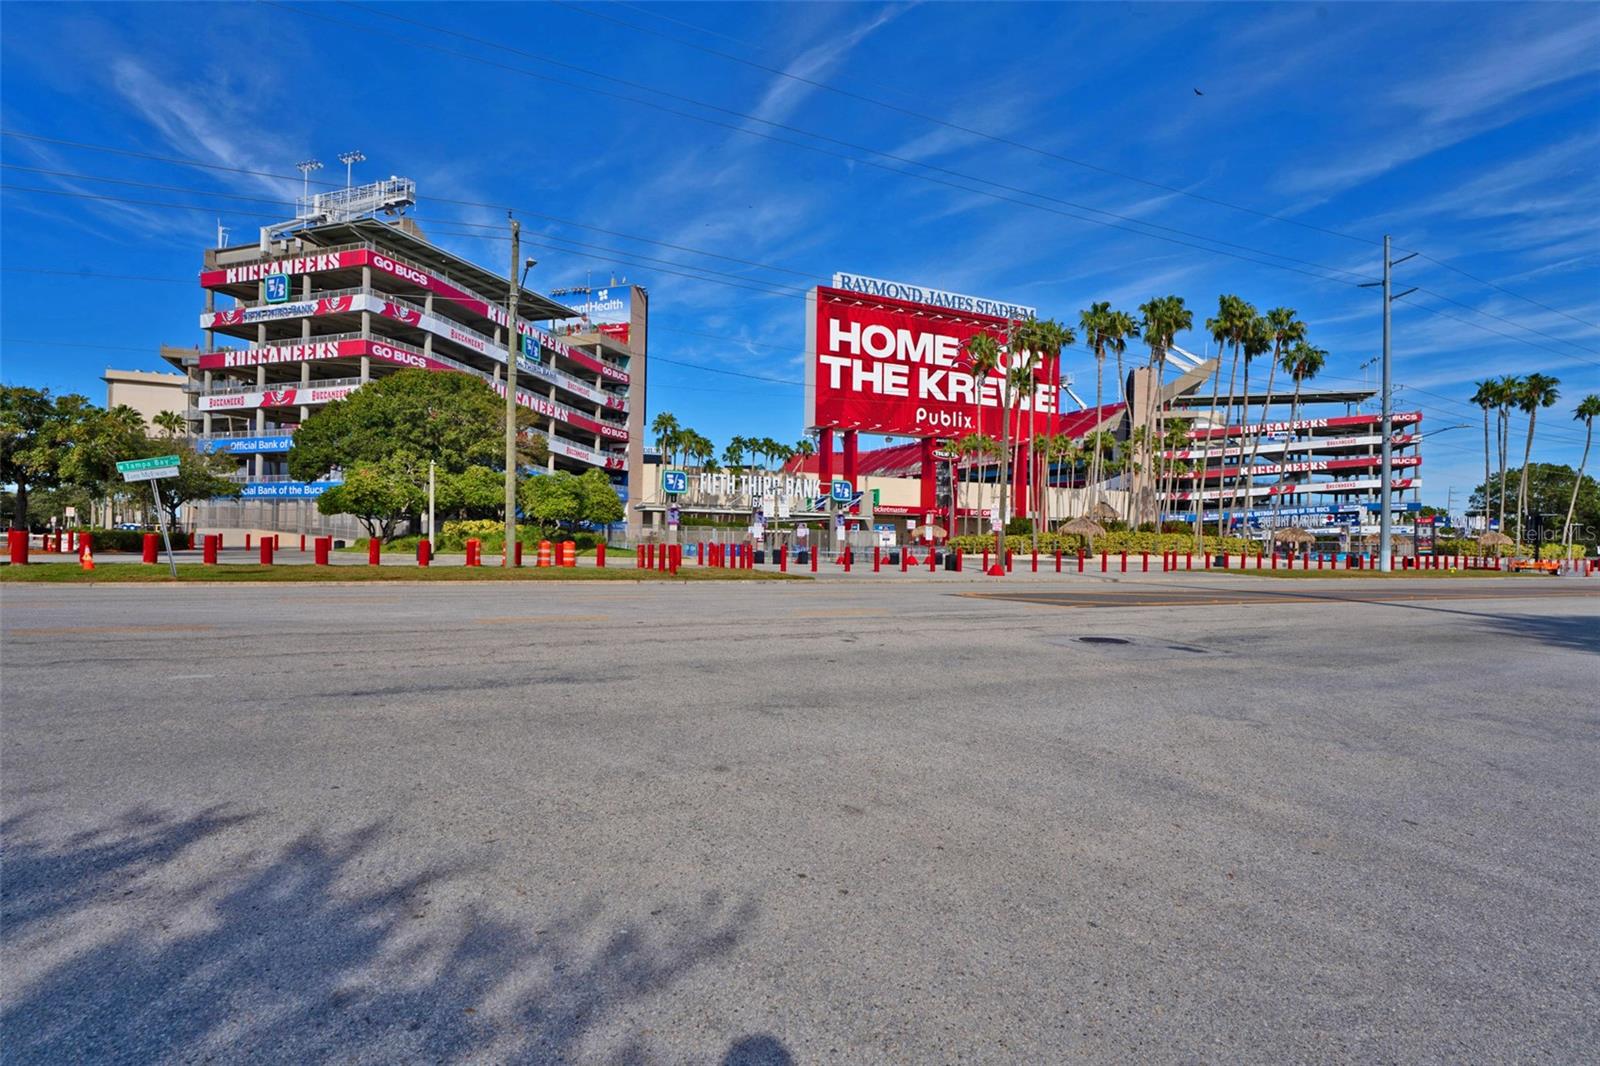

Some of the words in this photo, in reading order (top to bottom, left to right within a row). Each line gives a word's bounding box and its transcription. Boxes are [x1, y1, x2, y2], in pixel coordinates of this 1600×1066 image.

[226, 253, 341, 284] BUCCANEERS
[373, 256, 394, 272] GO
[395, 264, 428, 286] BUCS
[840, 275, 923, 303] RAYMOND
[924, 291, 973, 311] JAMES
[450, 328, 485, 352] BUCCANEERS
[829, 318, 959, 368] HOME
[224, 341, 340, 368] BUCCANEERS
[372, 344, 393, 359] GO
[394, 352, 427, 369] BUCS
[602, 366, 612, 376] GO
[613, 370, 629, 382] BUCS
[820, 355, 909, 397] THE
[209, 395, 245, 408] BUCCANEERS
[916, 407, 973, 429] Publix
[1392, 413, 1418, 421] BUCS
[601, 426, 612, 436] GO
[613, 428, 629, 440] BUCS
[230, 441, 257, 450] Official
[258, 440, 278, 449] Bank
[279, 440, 289, 449] of
[125, 461, 151, 470] Tampa
[153, 458, 169, 466] Bay
[1392, 457, 1418, 465] BUCS
[258, 486, 277, 495] Bank
[278, 485, 287, 495] of
[289, 485, 302, 495] the
[303, 485, 324, 495] Bucs
[700, 473, 736, 496] FIFTH
[786, 475, 821, 499] BANK
